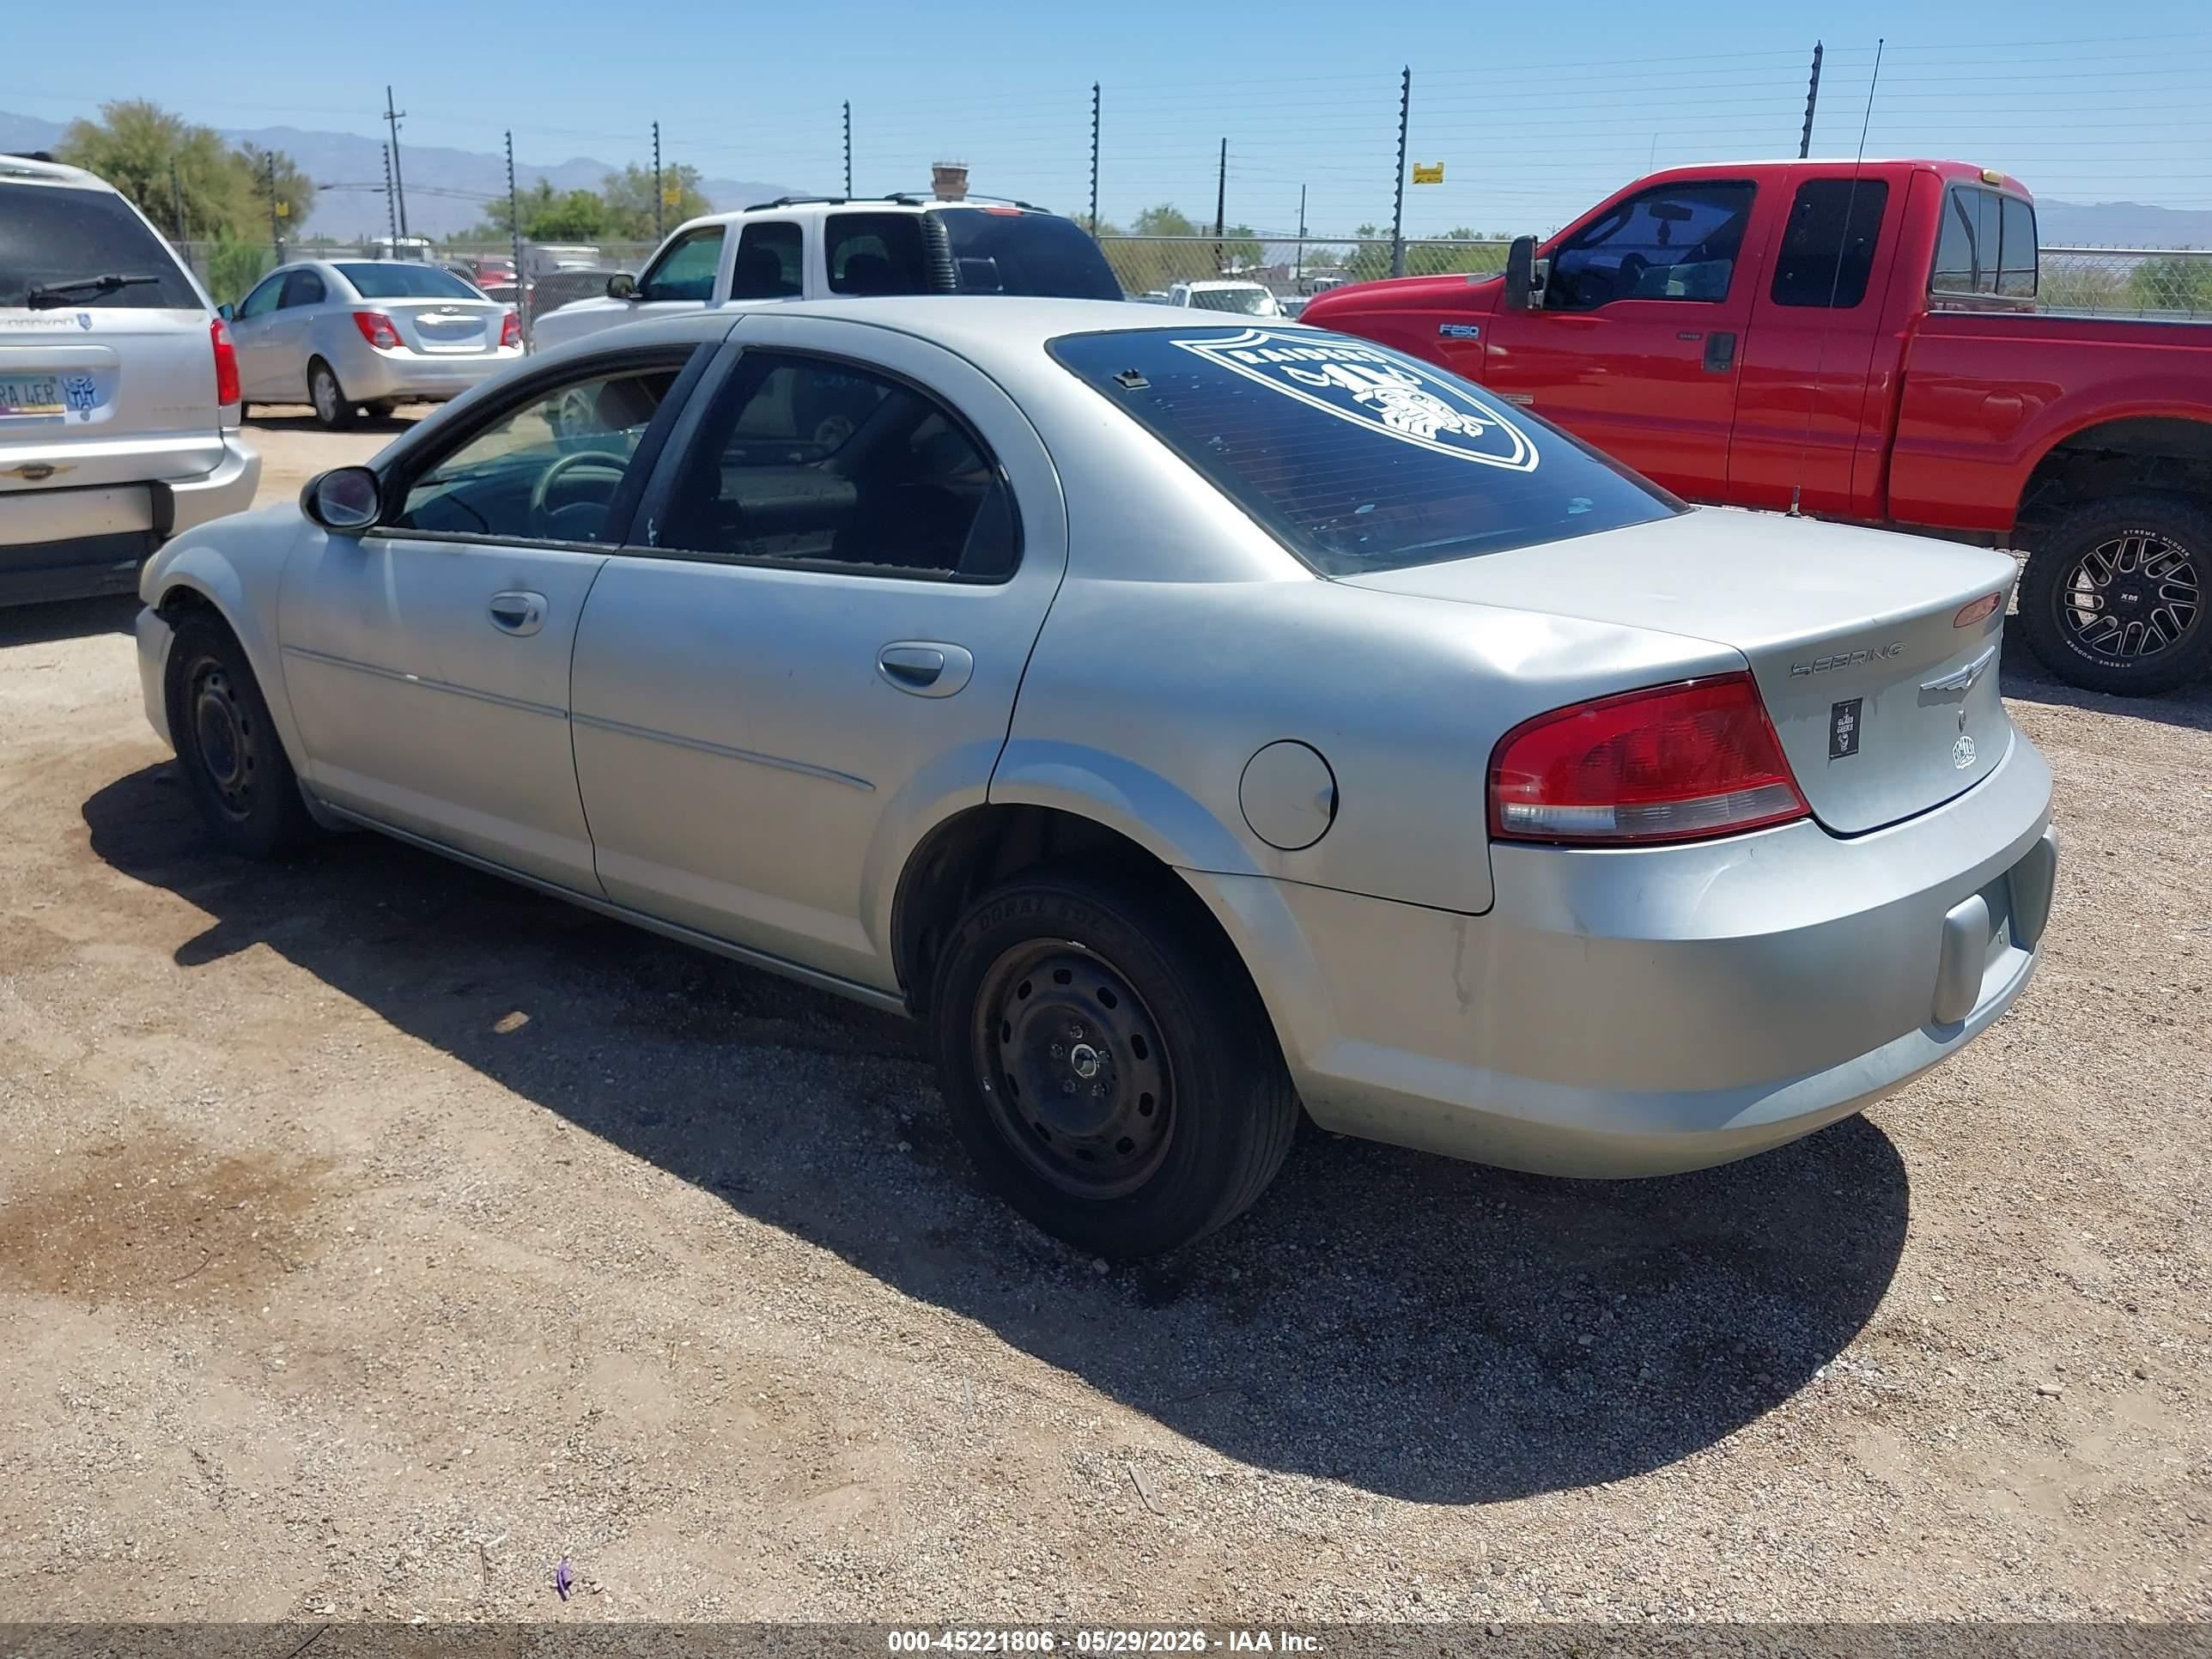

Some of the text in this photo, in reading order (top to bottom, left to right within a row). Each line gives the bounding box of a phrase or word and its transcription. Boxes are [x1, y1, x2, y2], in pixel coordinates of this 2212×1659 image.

[1439, 325, 1480, 336] F250
[1227, 348, 1388, 364] RAIDERS
[2123, 529, 2156, 538] XTREME
[2120, 592, 2138, 602] XM
[1790, 641, 1907, 678] SEBRING
